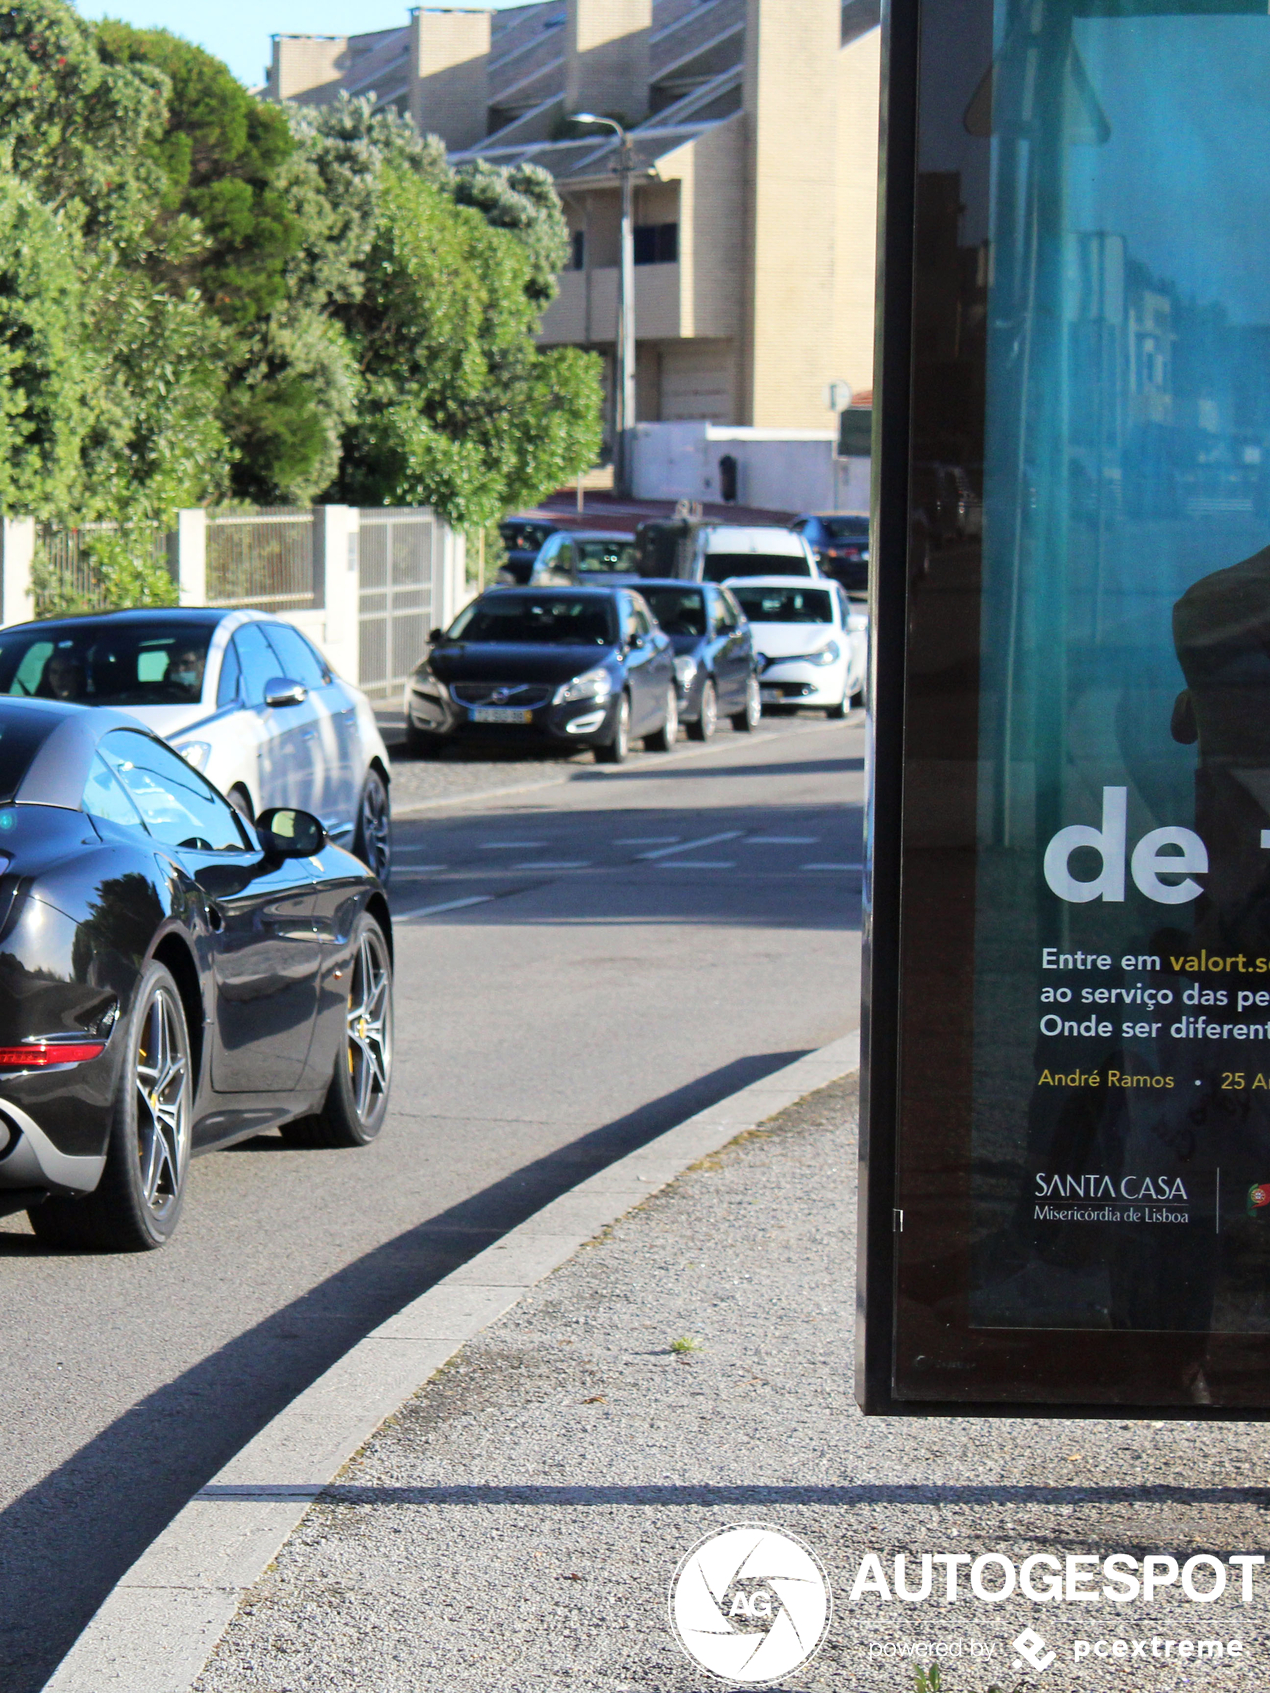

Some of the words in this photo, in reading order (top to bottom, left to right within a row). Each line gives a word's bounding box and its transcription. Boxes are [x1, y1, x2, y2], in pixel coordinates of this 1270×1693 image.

[1044, 786, 1208, 905] de
[1042, 948, 1112, 970] Entre
[1121, 954, 1160, 971] em
[1170, 949, 1270, 972] valort.s
[1040, 986, 1072, 1003] ao
[1081, 983, 1173, 1010] serviço
[1182, 982, 1228, 1006] das
[1040, 1014, 1113, 1037] Onde
[1122, 1021, 1161, 1038] ser
[1038, 1069, 1100, 1087] André
[1108, 1070, 1175, 1088] Ramos
[1221, 1073, 1245, 1090] 25
[1252, 1074, 1270, 1090] A
[1035, 1172, 1116, 1198] SANTA
[1120, 1175, 1188, 1200] CASA
[1034, 1205, 1120, 1222] Misericórdia
[1124, 1207, 1141, 1223] de
[1145, 1207, 1189, 1223] Lisboa
